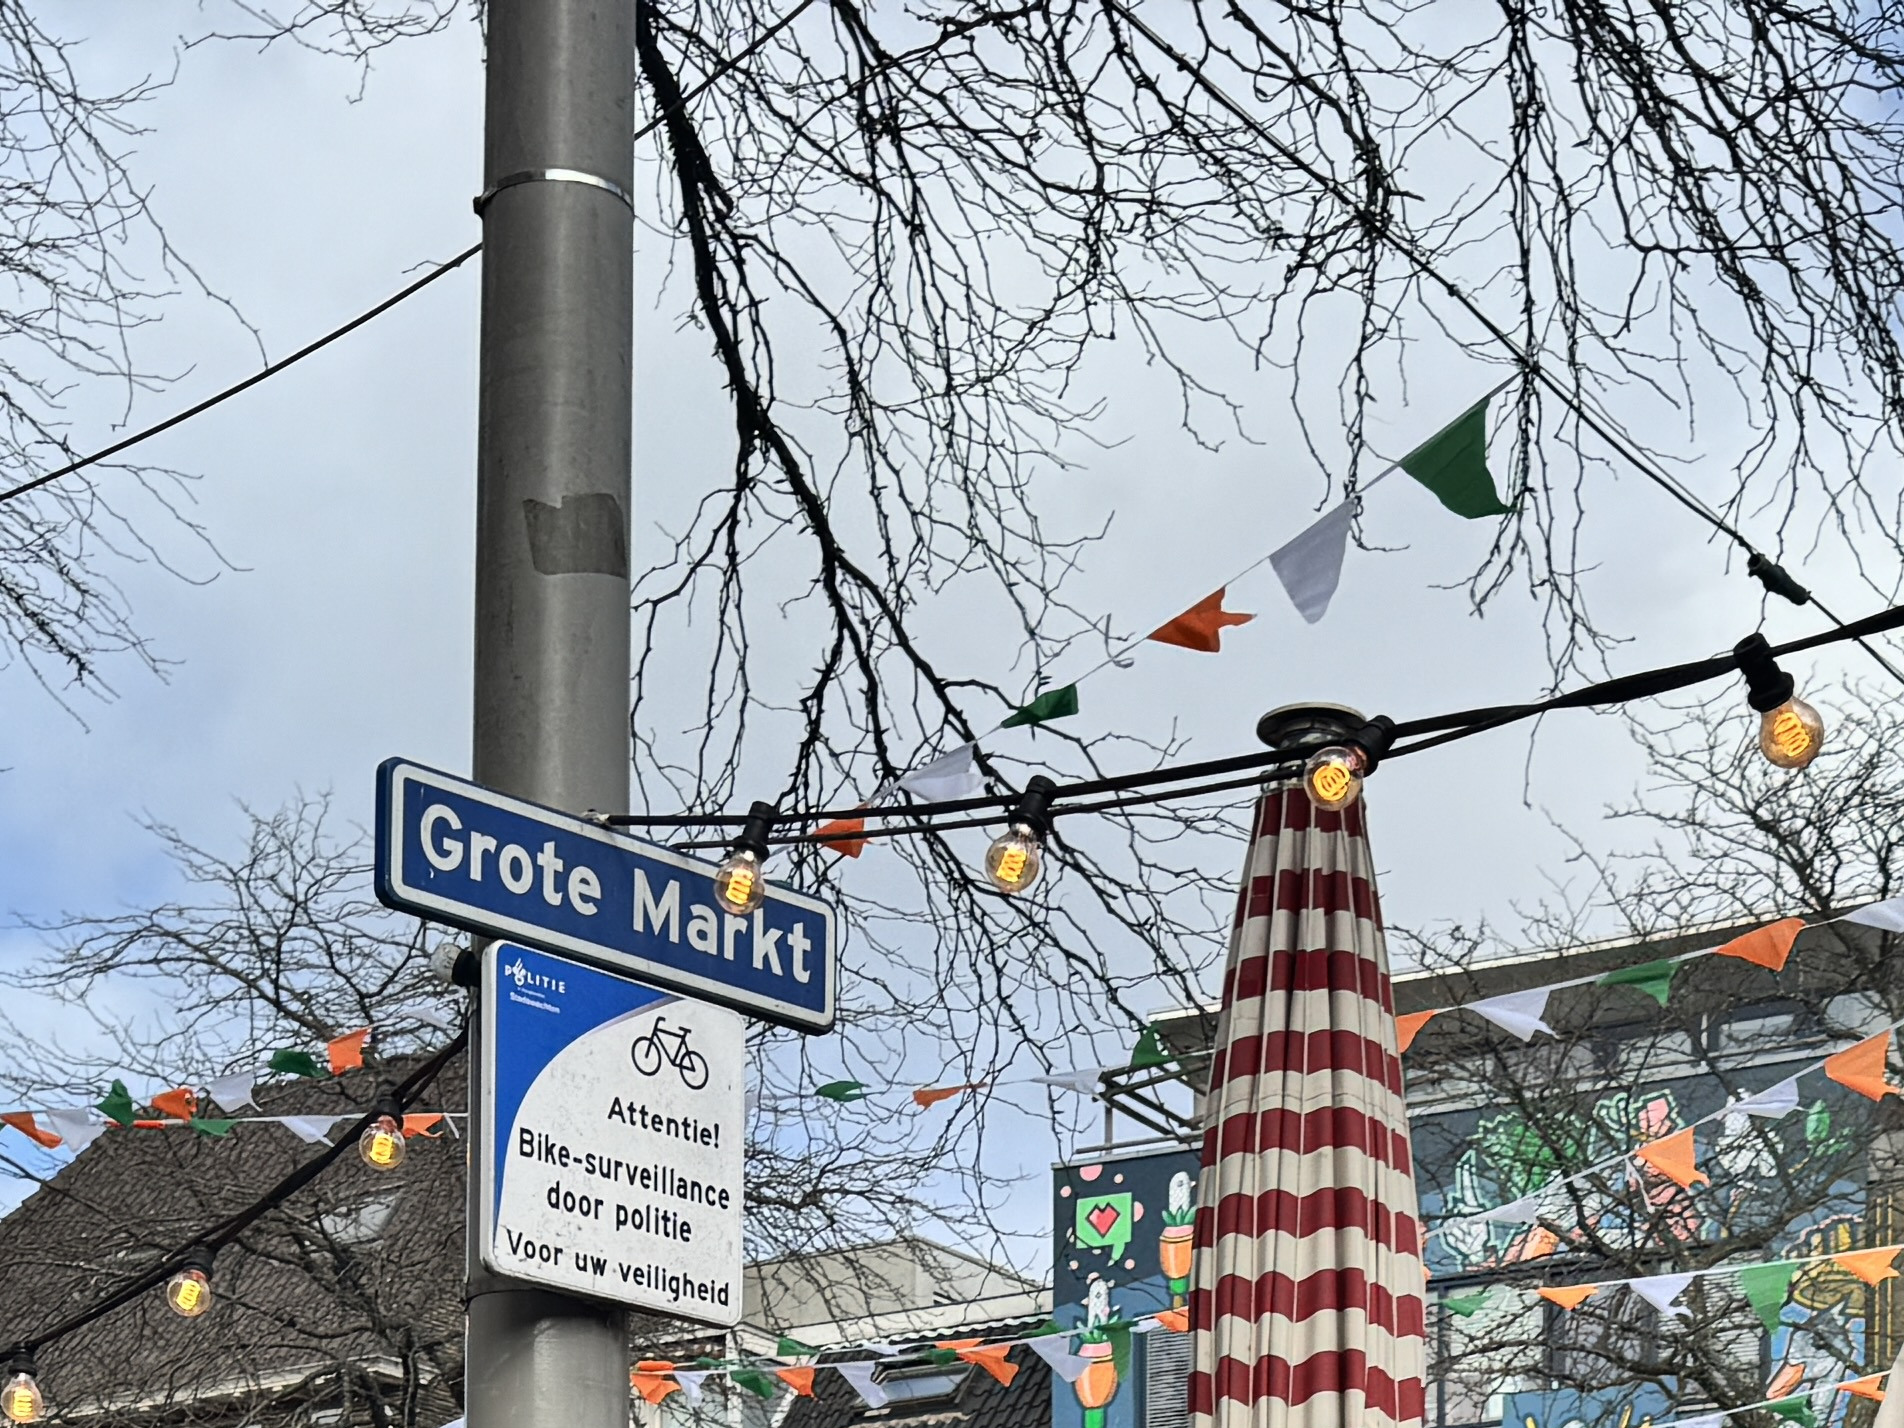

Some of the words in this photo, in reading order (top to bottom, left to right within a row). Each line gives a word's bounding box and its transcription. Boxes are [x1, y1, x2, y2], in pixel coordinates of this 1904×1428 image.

[420, 803, 602, 916] Grote
[632, 867, 812, 984] Markt
[607, 1096, 720, 1150] Attentie!
[519, 1126, 731, 1210] Bike-surveillance
[547, 1180, 604, 1220] door
[615, 1204, 692, 1243] politie
[507, 1228, 564, 1266] Voor
[574, 1251, 608, 1278] uw
[618, 1261, 730, 1307] veiligheid
